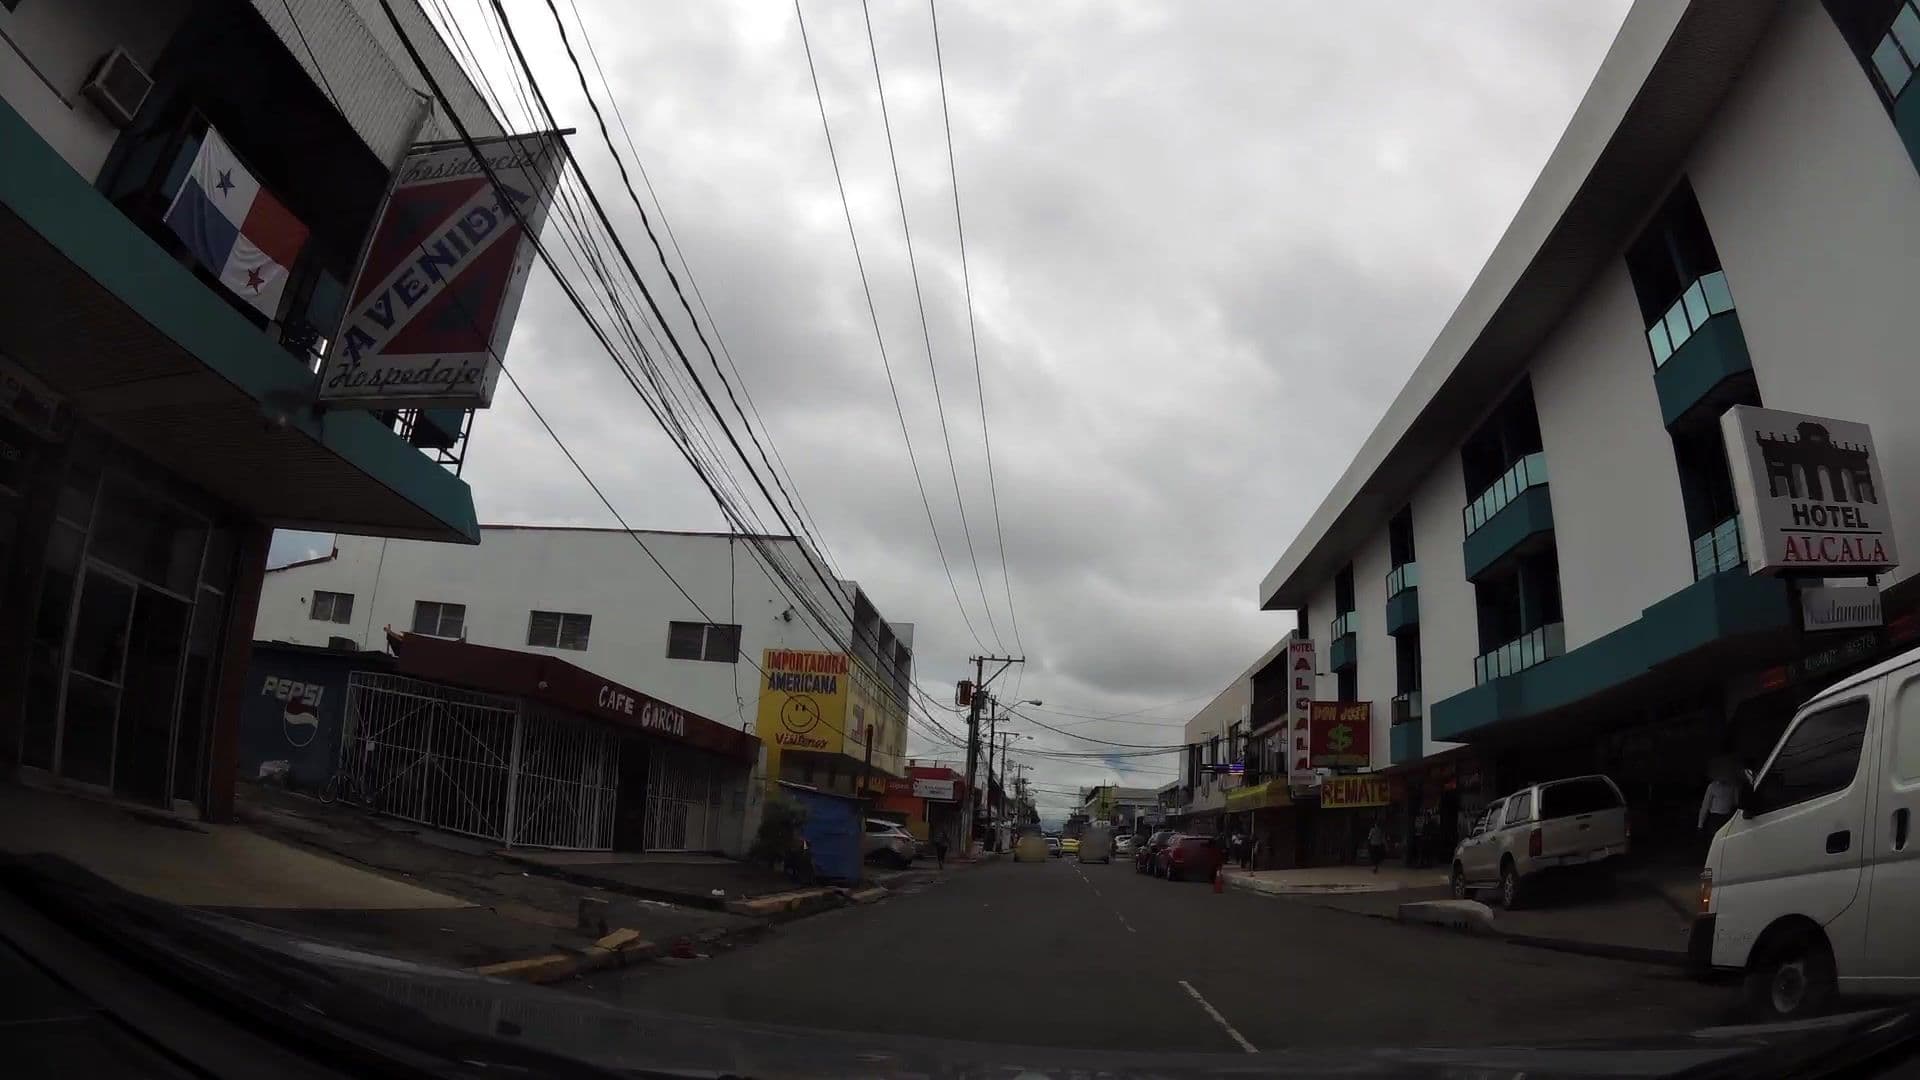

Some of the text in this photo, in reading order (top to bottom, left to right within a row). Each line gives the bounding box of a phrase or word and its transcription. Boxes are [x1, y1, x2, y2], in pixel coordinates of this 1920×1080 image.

[343, 183, 530, 366] AVENIDA
[328, 359, 481, 393] Hospedaje
[1791, 503, 1869, 529] HOTEL
[1782, 535, 1889, 563] ALCALA
[1290, 641, 1315, 652] HOTEL
[767, 651, 849, 675] IMPORTADORA
[261, 676, 324, 707] PEPSI
[767, 671, 837, 696] AMERICANA
[599, 685, 684, 737] CAFE GARCIA
[1321, 780, 1392, 804] REMATE
